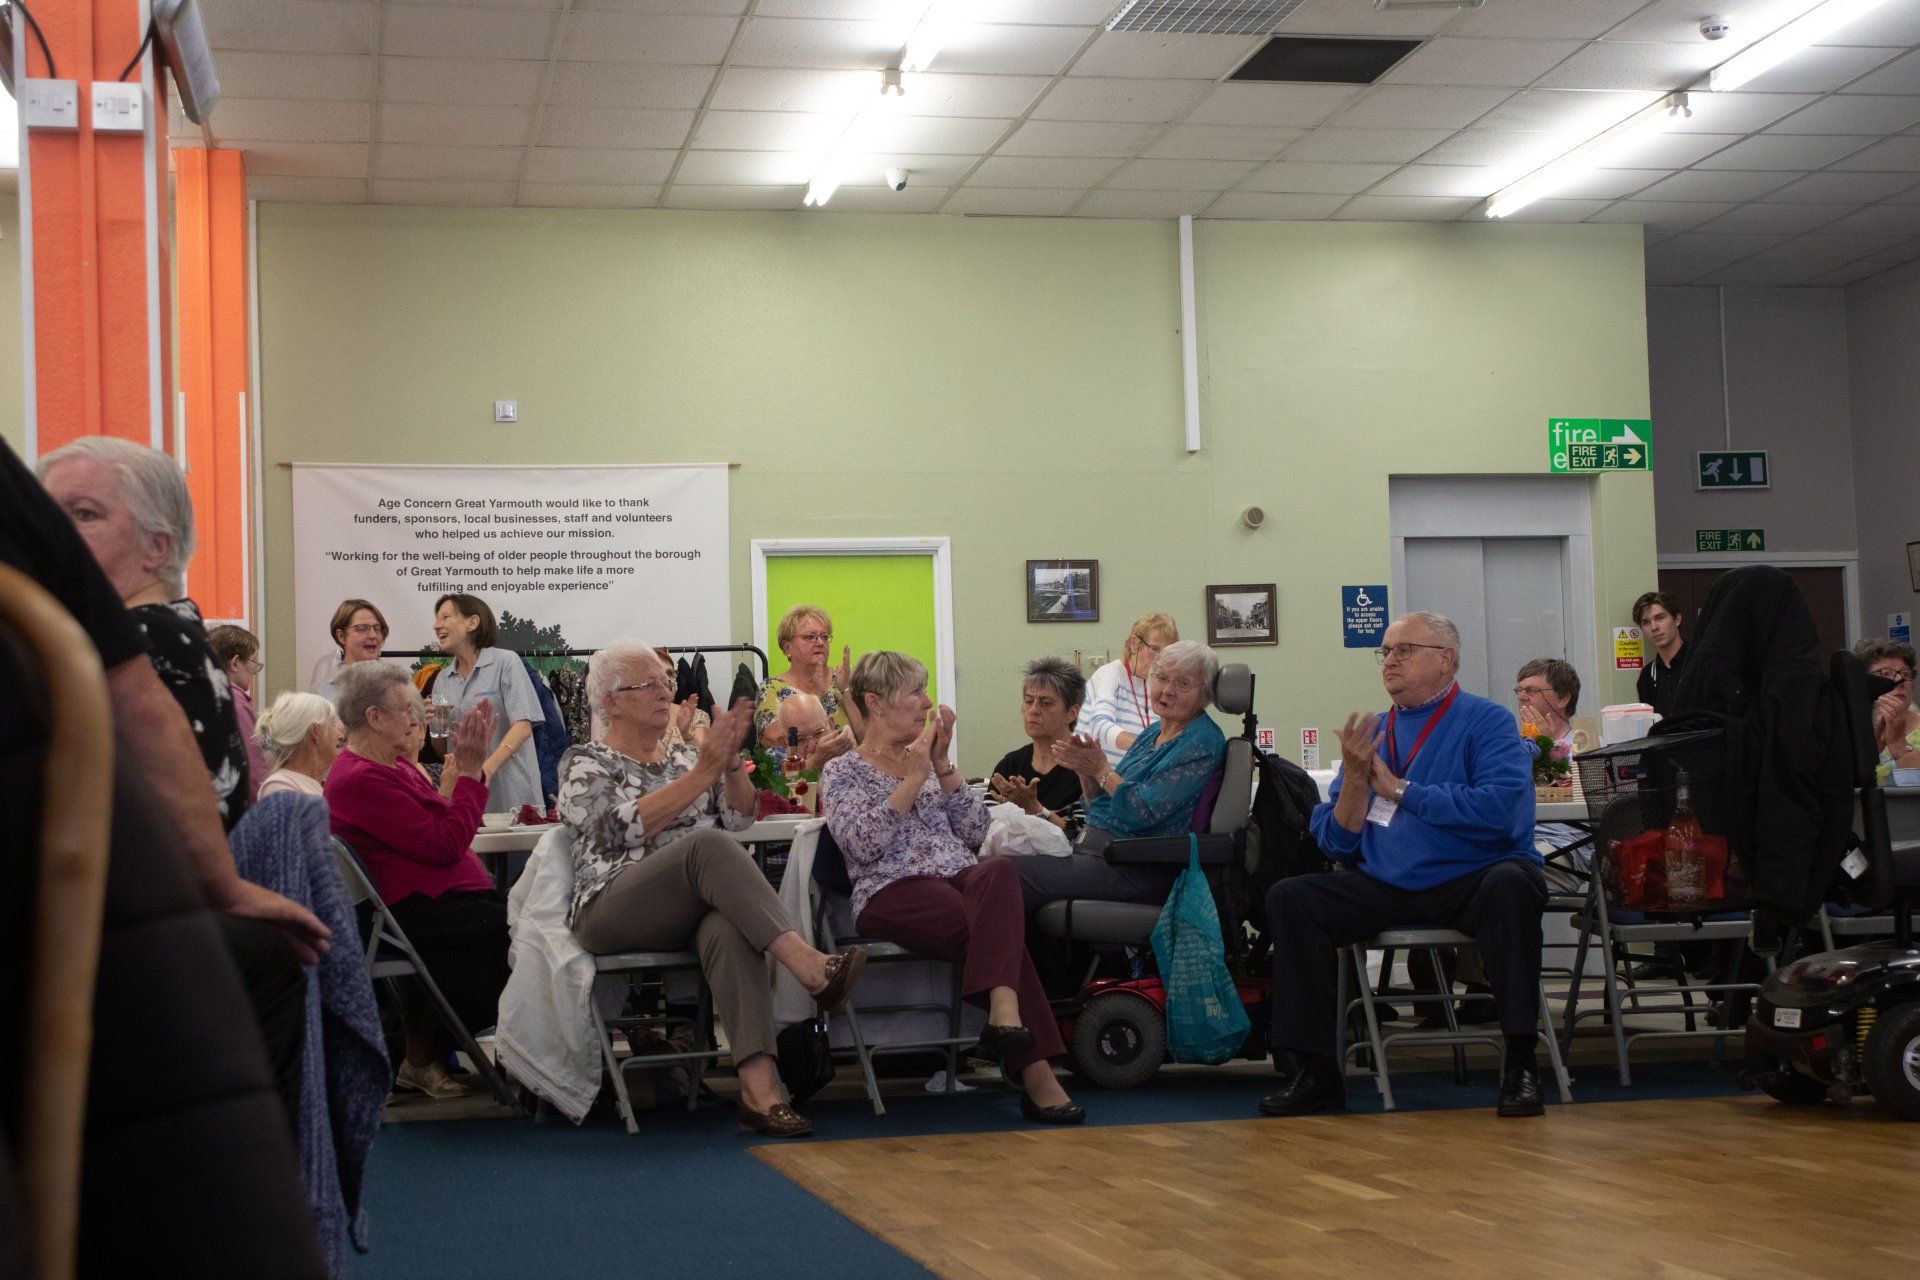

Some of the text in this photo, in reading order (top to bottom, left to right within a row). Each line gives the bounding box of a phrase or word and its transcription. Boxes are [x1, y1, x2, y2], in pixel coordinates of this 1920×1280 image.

[1553, 422, 1597, 446] fire
[1572, 446, 1597, 456] FIRE
[1572, 457, 1597, 467] EXIT
[377, 497, 650, 511] Age Concern Great Yarmouth would like to thank
[353, 512, 673, 527] funders, sponsors, local businesses, staff and volunteers
[414, 528, 615, 542] who helped us achieve our mission.
[1700, 531, 1721, 540] FIRE
[1700, 541, 1721, 550] EXIT
[381, 550, 399, 561] for
[400, 550, 420, 561] the
[422, 550, 481, 564] well-being
[484, 551, 495, 560] of
[497, 550, 528, 561] older
[529, 549, 568, 563] people
[569, 549, 632, 563] throughout
[633, 549, 653, 560] the
[654, 548, 702, 561] borough
[396, 567, 407, 576] of
[410, 566, 443, 577] Great
[444, 565, 500, 577] Yarmouth
[502, 567, 513, 575] to
[516, 565, 541, 578] help
[543, 565, 574, 576] make
[576, 564, 594, 575] life
[605, 566, 635, 576] more
[416, 581, 464, 594] fulfilling
[466, 581, 488, 592] and
[490, 581, 546, 594] enjoyable
